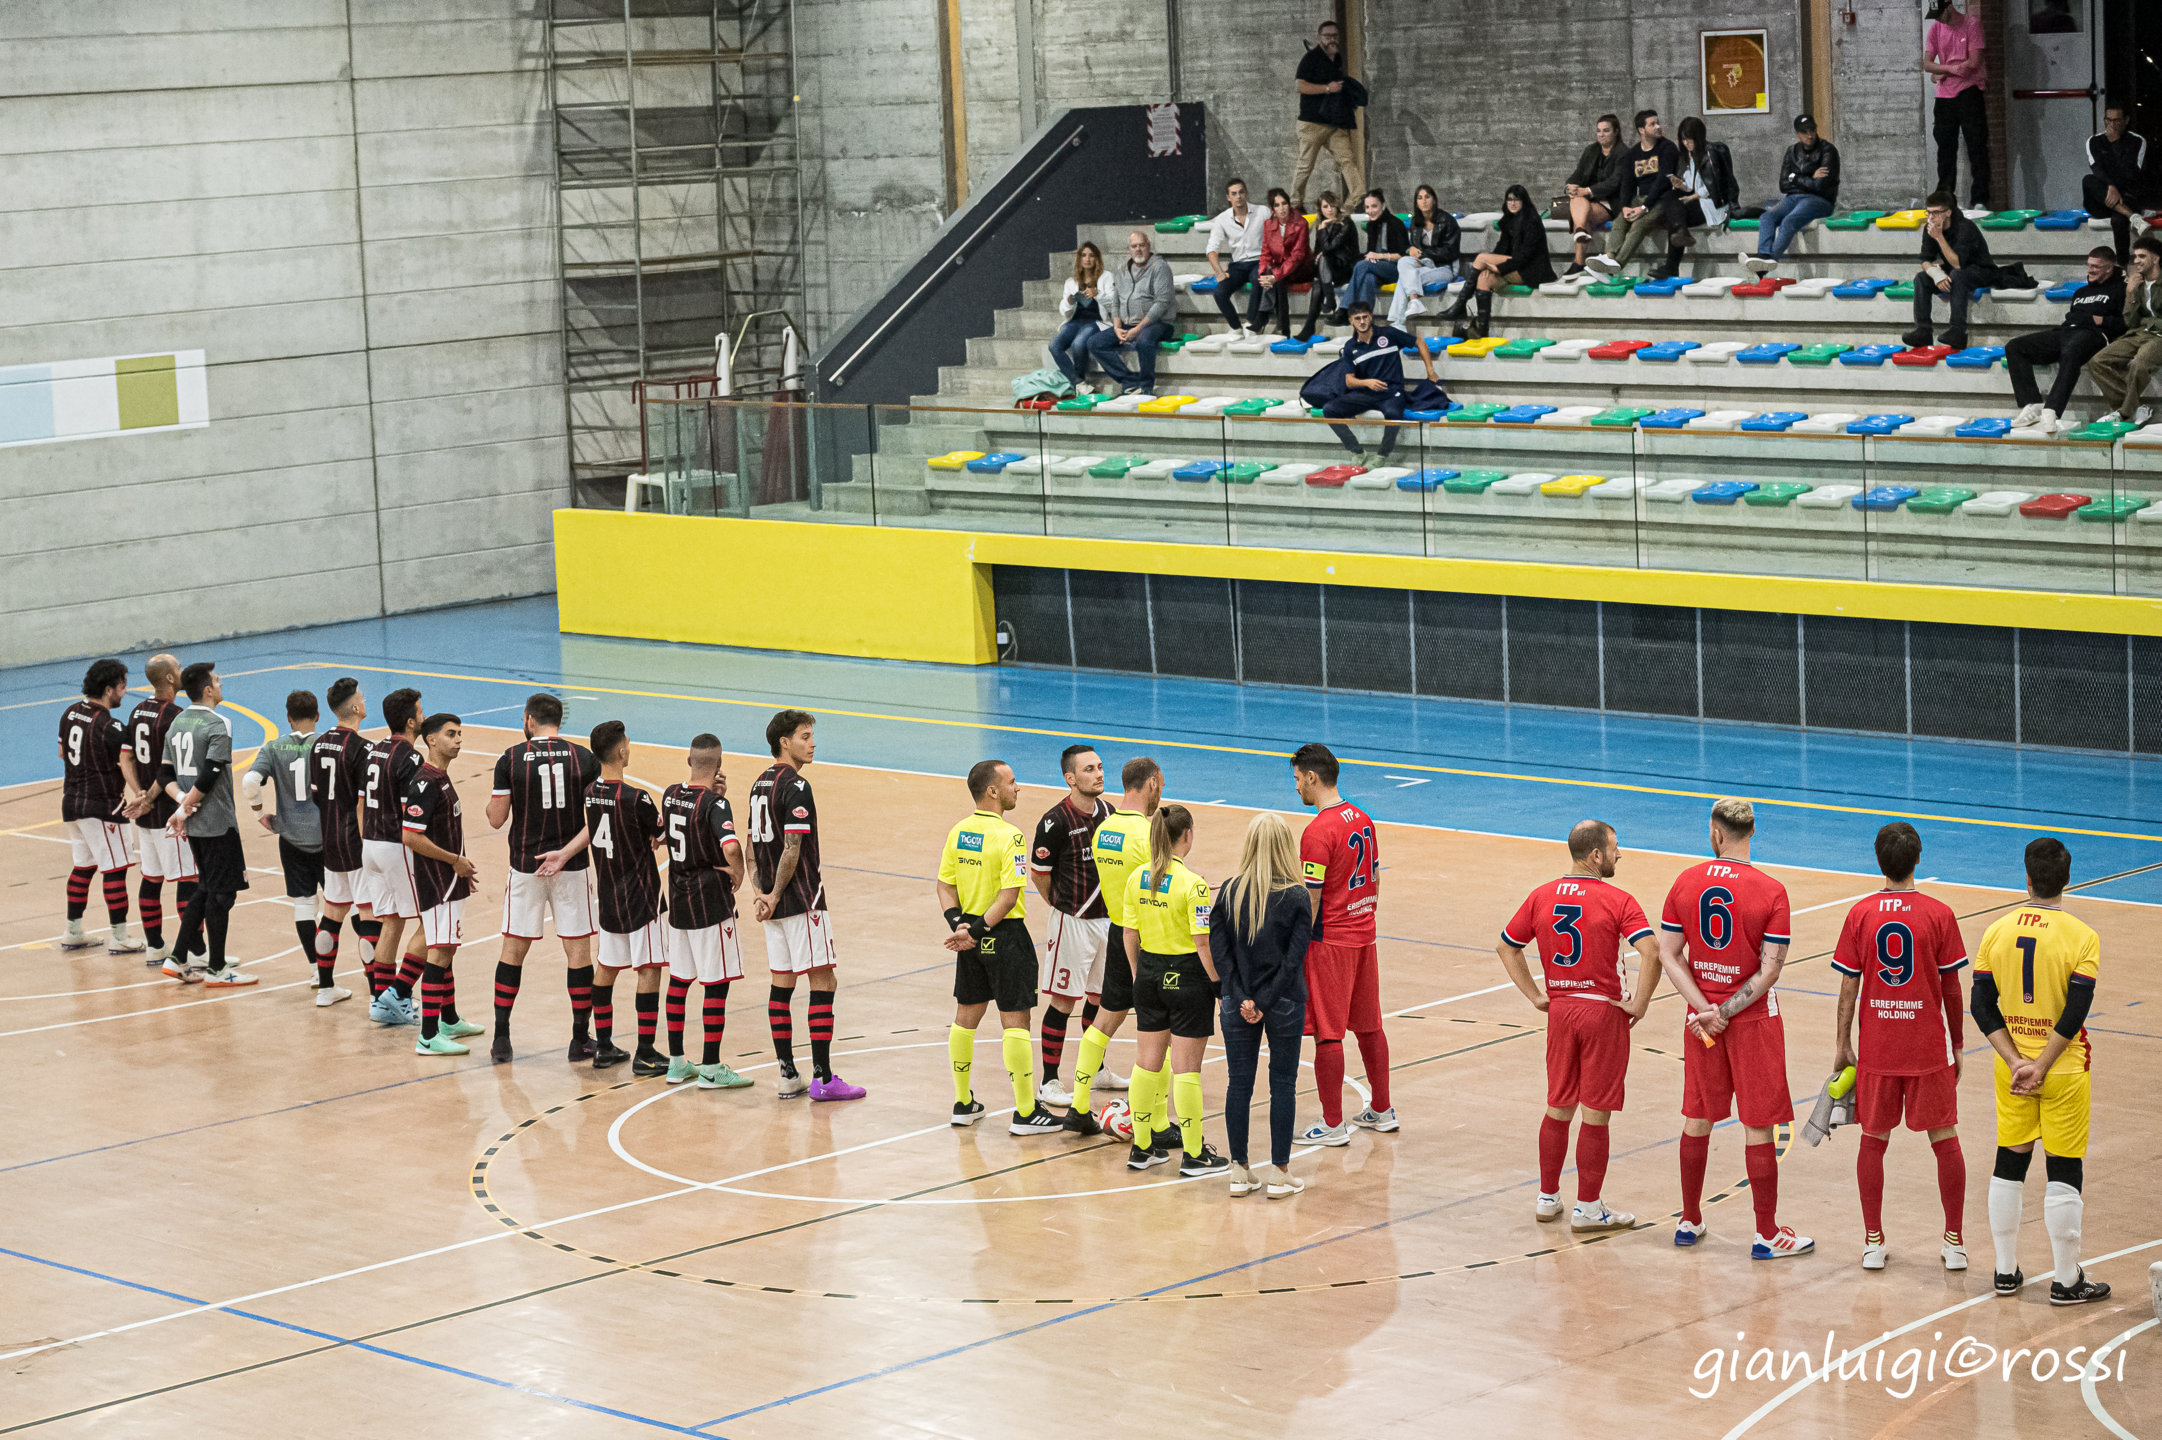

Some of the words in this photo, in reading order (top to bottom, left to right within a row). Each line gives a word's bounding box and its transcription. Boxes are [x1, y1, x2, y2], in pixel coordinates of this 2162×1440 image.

[68, 725, 83, 766] 9
[135, 723, 150, 764] 6
[171, 731, 197, 776] 12
[289, 758, 306, 801] 1
[321, 757, 336, 800] 7
[366, 764, 380, 808] 2
[538, 763, 565, 809] 11
[751, 795, 774, 842] 10
[1340, 808, 1354, 823] ITP
[592, 813, 613, 859] 4
[669, 813, 687, 862] 5
[958, 857, 982, 867] GIVOVA
[1097, 856, 1124, 866] GIVOVA
[1348, 826, 1376, 890] 21
[1305, 863, 1315, 875] C
[1706, 865, 1731, 878] ITP
[1556, 883, 1579, 896] ITP
[1139, 898, 1168, 908] GIVOVA
[1879, 898, 1902, 912] ITP
[1699, 885, 1734, 950] 6
[2017, 913, 2041, 927] ITP
[1552, 904, 1583, 967] 3
[1875, 921, 1914, 987] 9
[1694, 961, 1741, 975] ERREPIEMME
[1701, 972, 1732, 984] HOLDING
[2015, 935, 2037, 1004] 1
[1057, 969, 1071, 990] 3
[1870, 999, 1923, 1009] ERREPIEMME
[1878, 1010, 1915, 1020] HOLDING
[2003, 1016, 2053, 1028] ERREPIEMME
[2011, 1026, 2047, 1036] HOLDING
